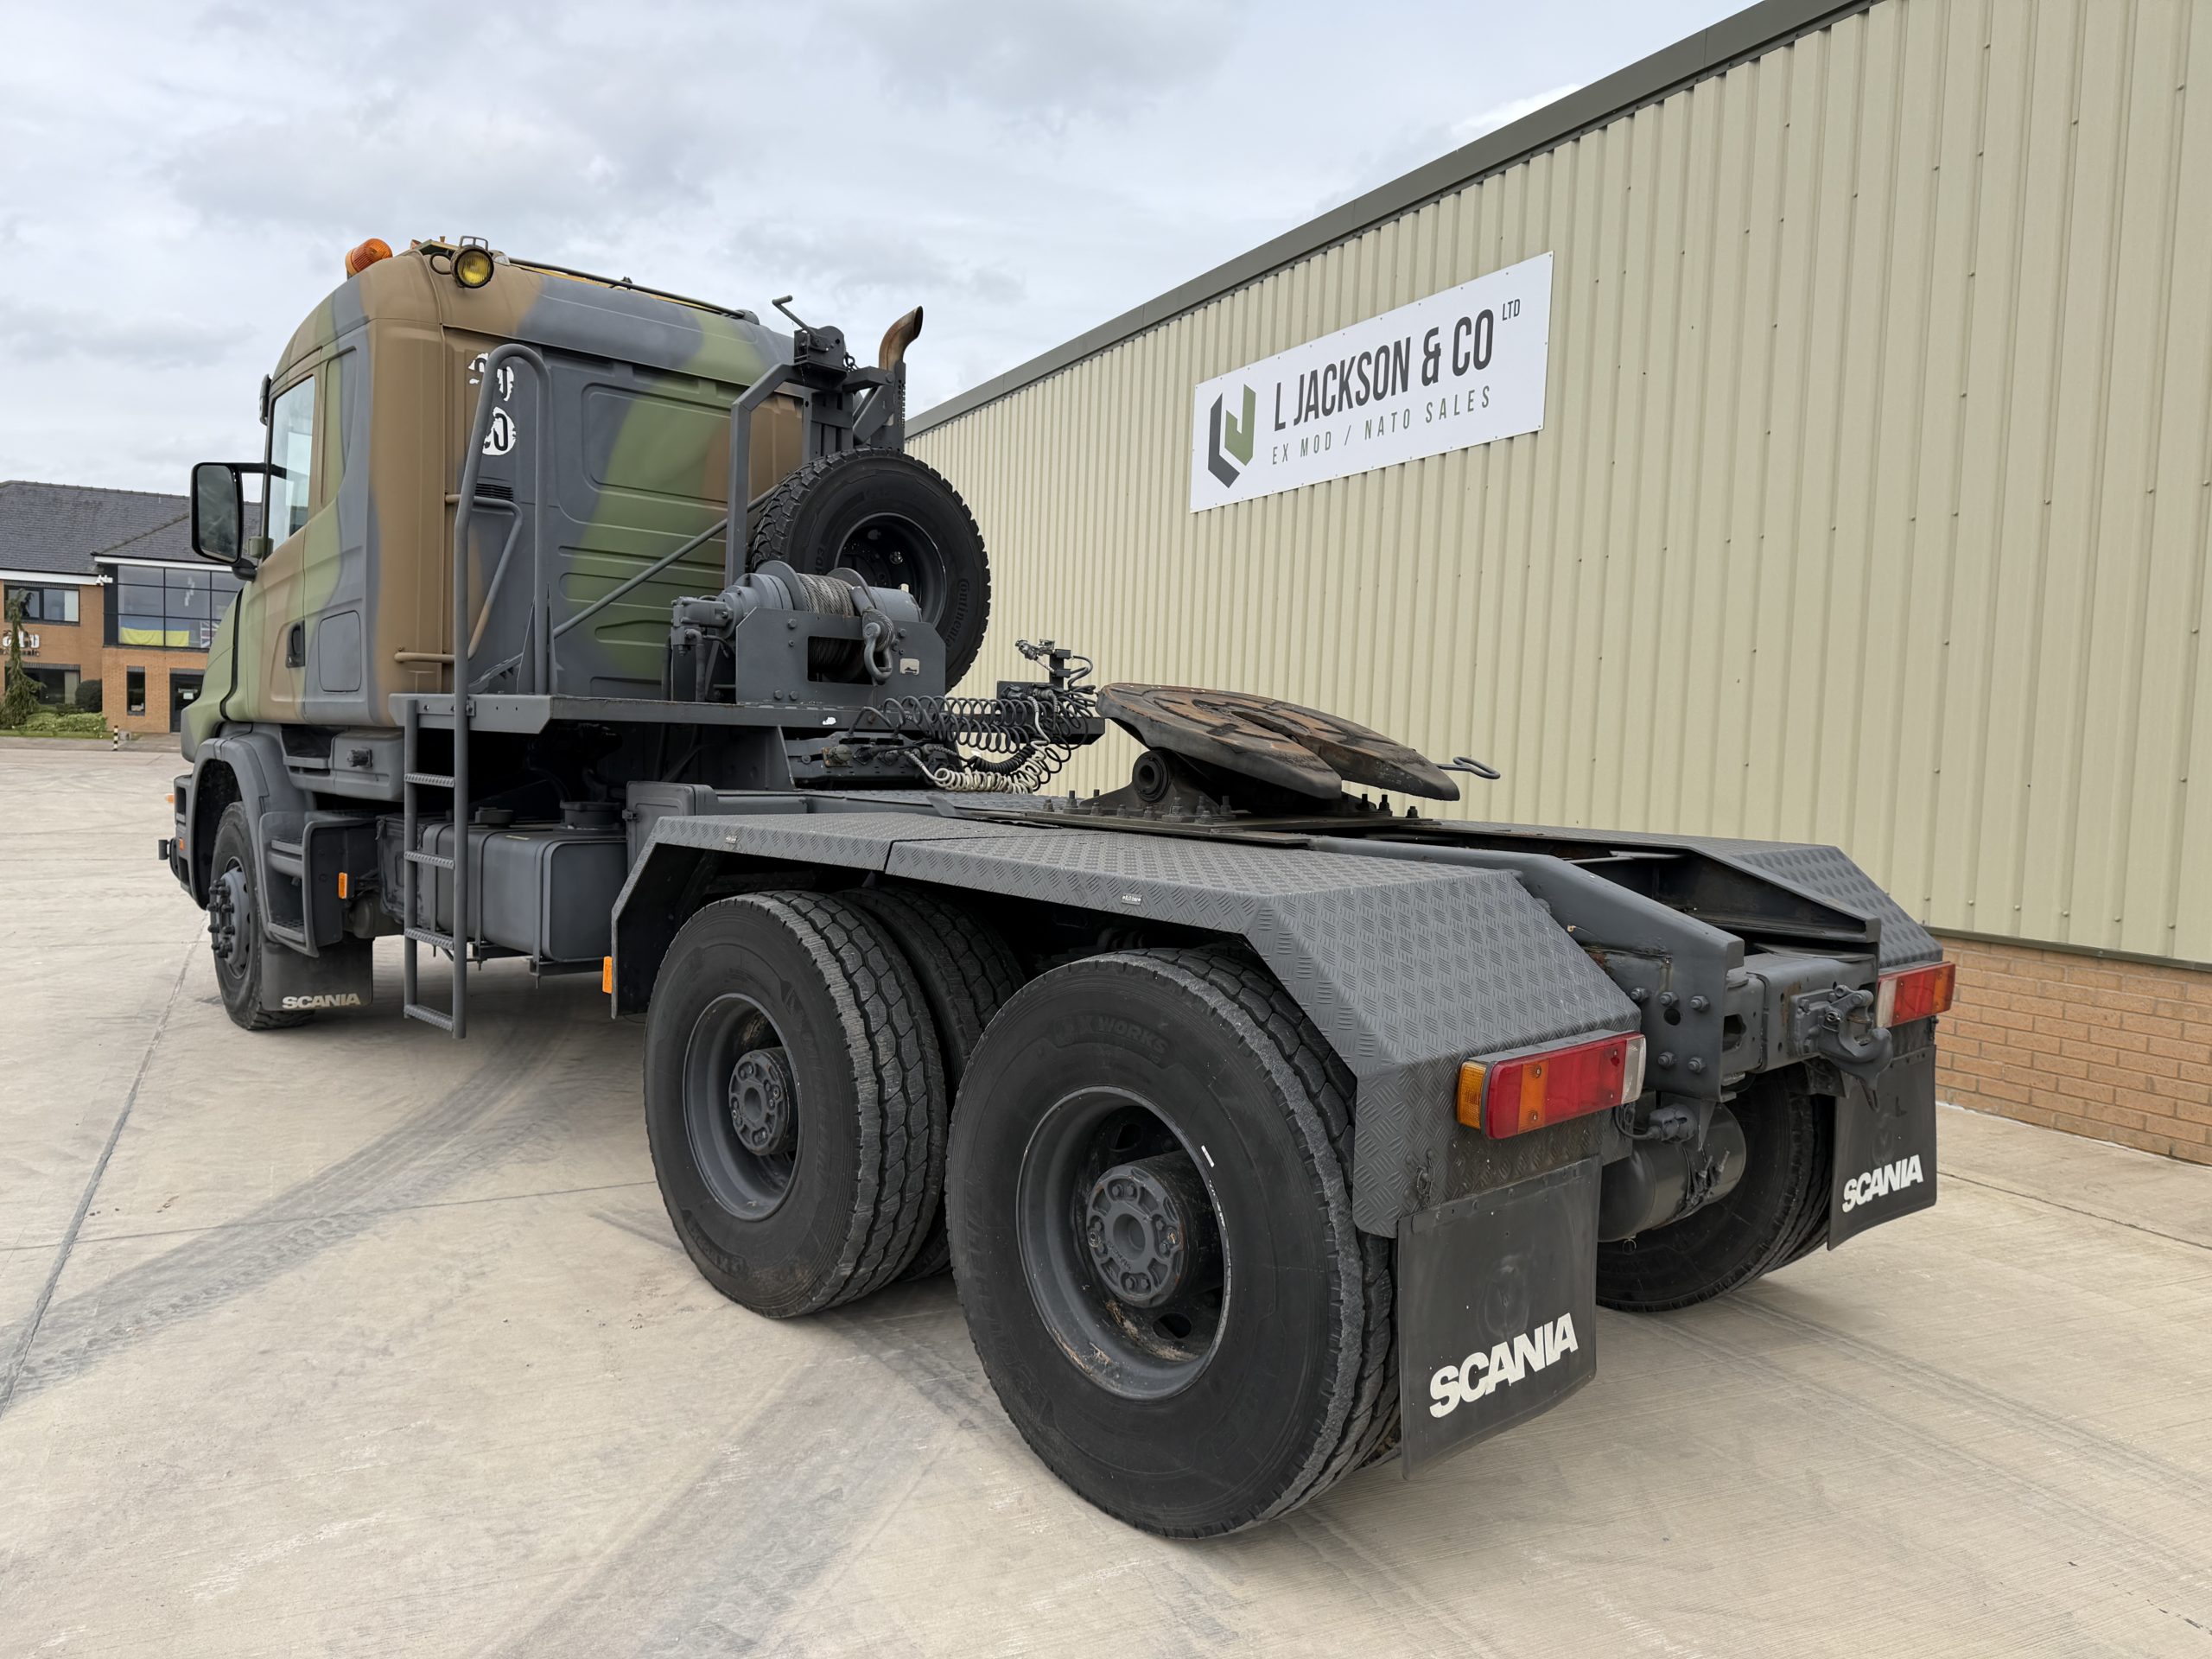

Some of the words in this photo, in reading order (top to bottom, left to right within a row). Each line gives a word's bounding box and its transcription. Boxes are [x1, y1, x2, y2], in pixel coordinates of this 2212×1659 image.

[1274, 381, 1287, 432] L
[1294, 336, 1411, 427] JACKSON
[1421, 326, 1441, 387] &
[1452, 308, 1494, 377] CO
[1502, 298, 1521, 321] LTD
[1272, 442, 1289, 465] EX
[1300, 430, 1332, 458] MOD
[1364, 408, 1411, 441] NATO
[1425, 385, 1491, 423] SALES
[945, 577, 969, 653] Continenta
[281, 993, 361, 1010] SCANIA
[1841, 1154, 1923, 1213] SCANIA
[1428, 1312, 1579, 1419] SCANIA
